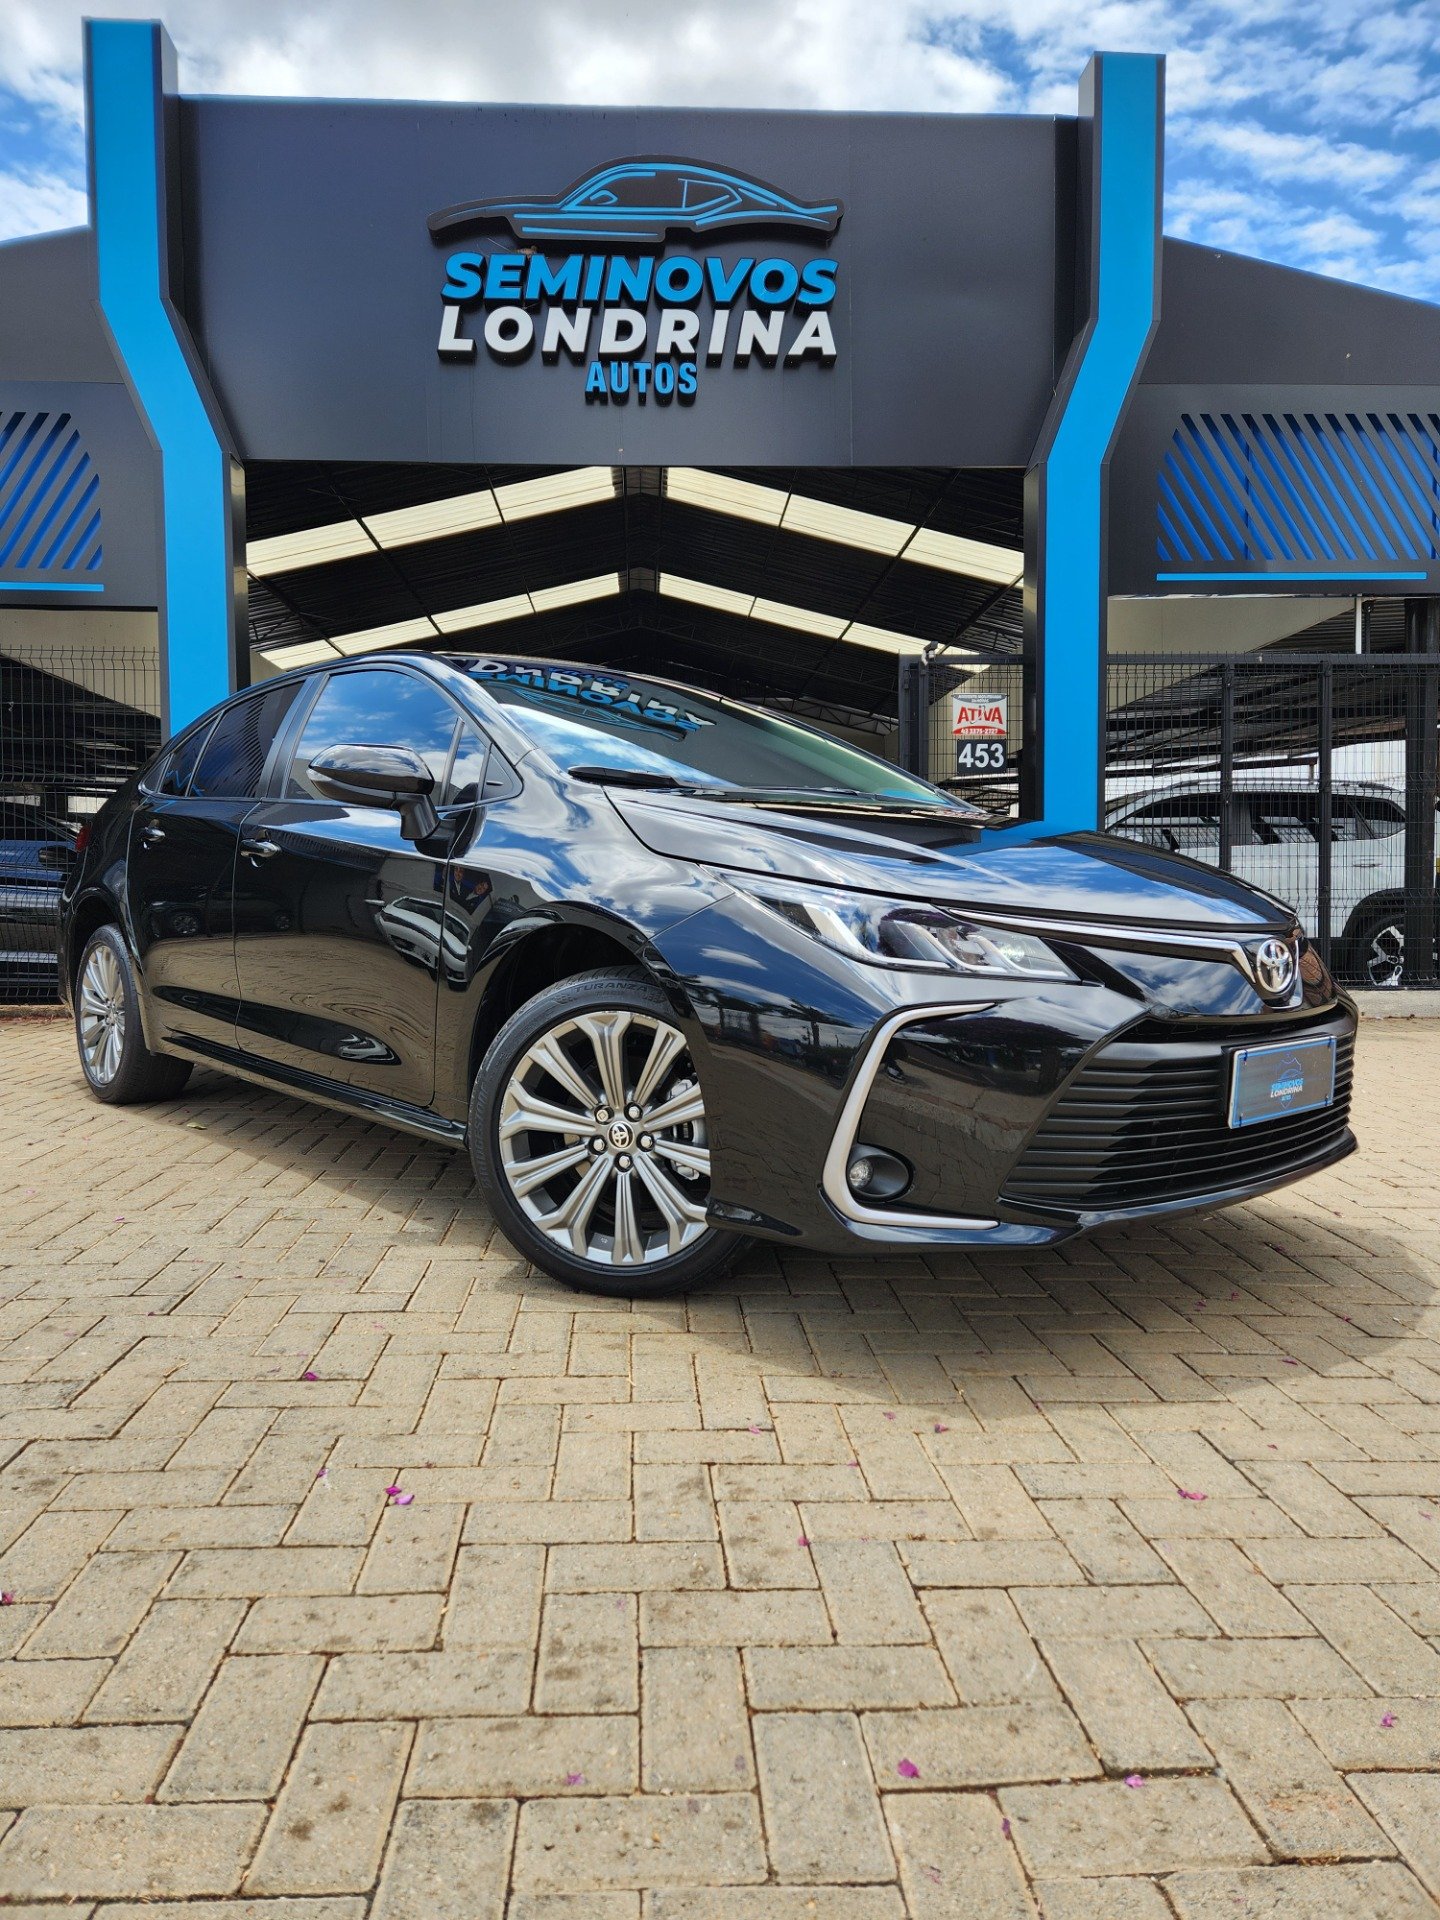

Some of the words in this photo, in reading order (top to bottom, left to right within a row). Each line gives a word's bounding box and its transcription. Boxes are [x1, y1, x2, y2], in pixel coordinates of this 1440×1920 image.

[441, 251, 840, 306] SEMINOVOS
[437, 305, 838, 360] LONDRINA
[585, 361, 698, 397] AUTOS
[958, 743, 1005, 768] 453
[575, 981, 648, 993] TURANZA
